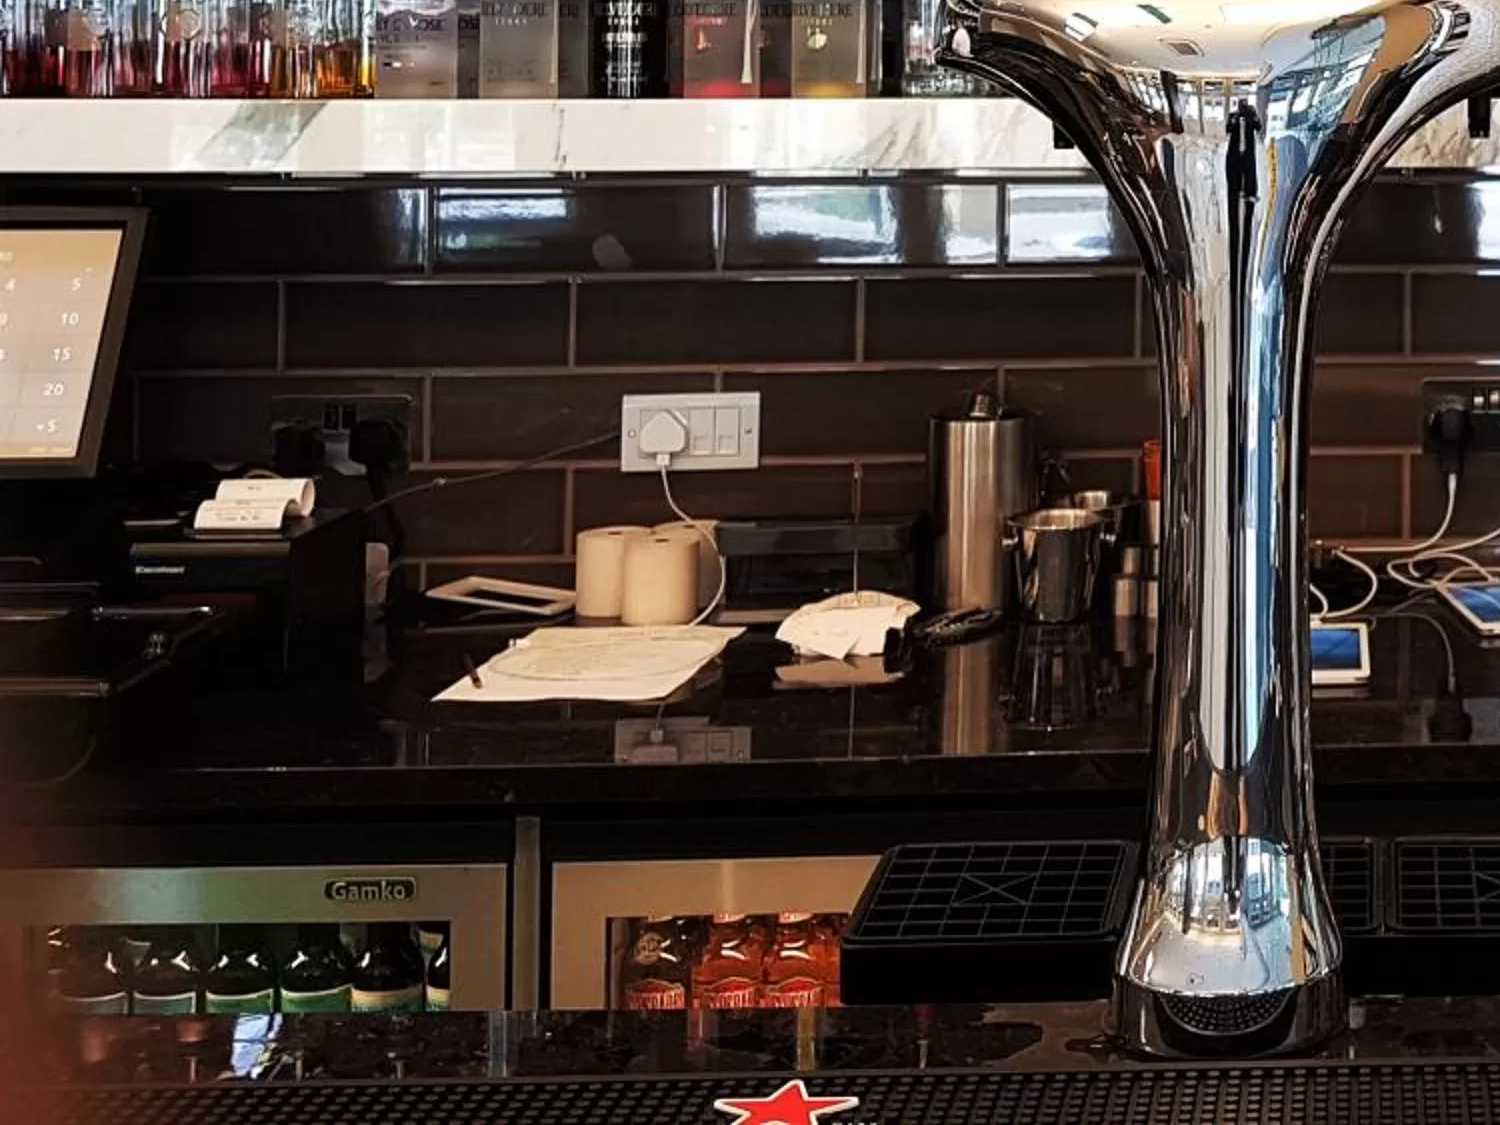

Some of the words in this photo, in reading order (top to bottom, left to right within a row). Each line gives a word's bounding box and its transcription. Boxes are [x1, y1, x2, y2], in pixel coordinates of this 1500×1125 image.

[61, 313, 80, 326] 10
[53, 347, 73, 361] 15
[43, 383, 65, 397] 20
[331, 880, 407, 900] Gamko
